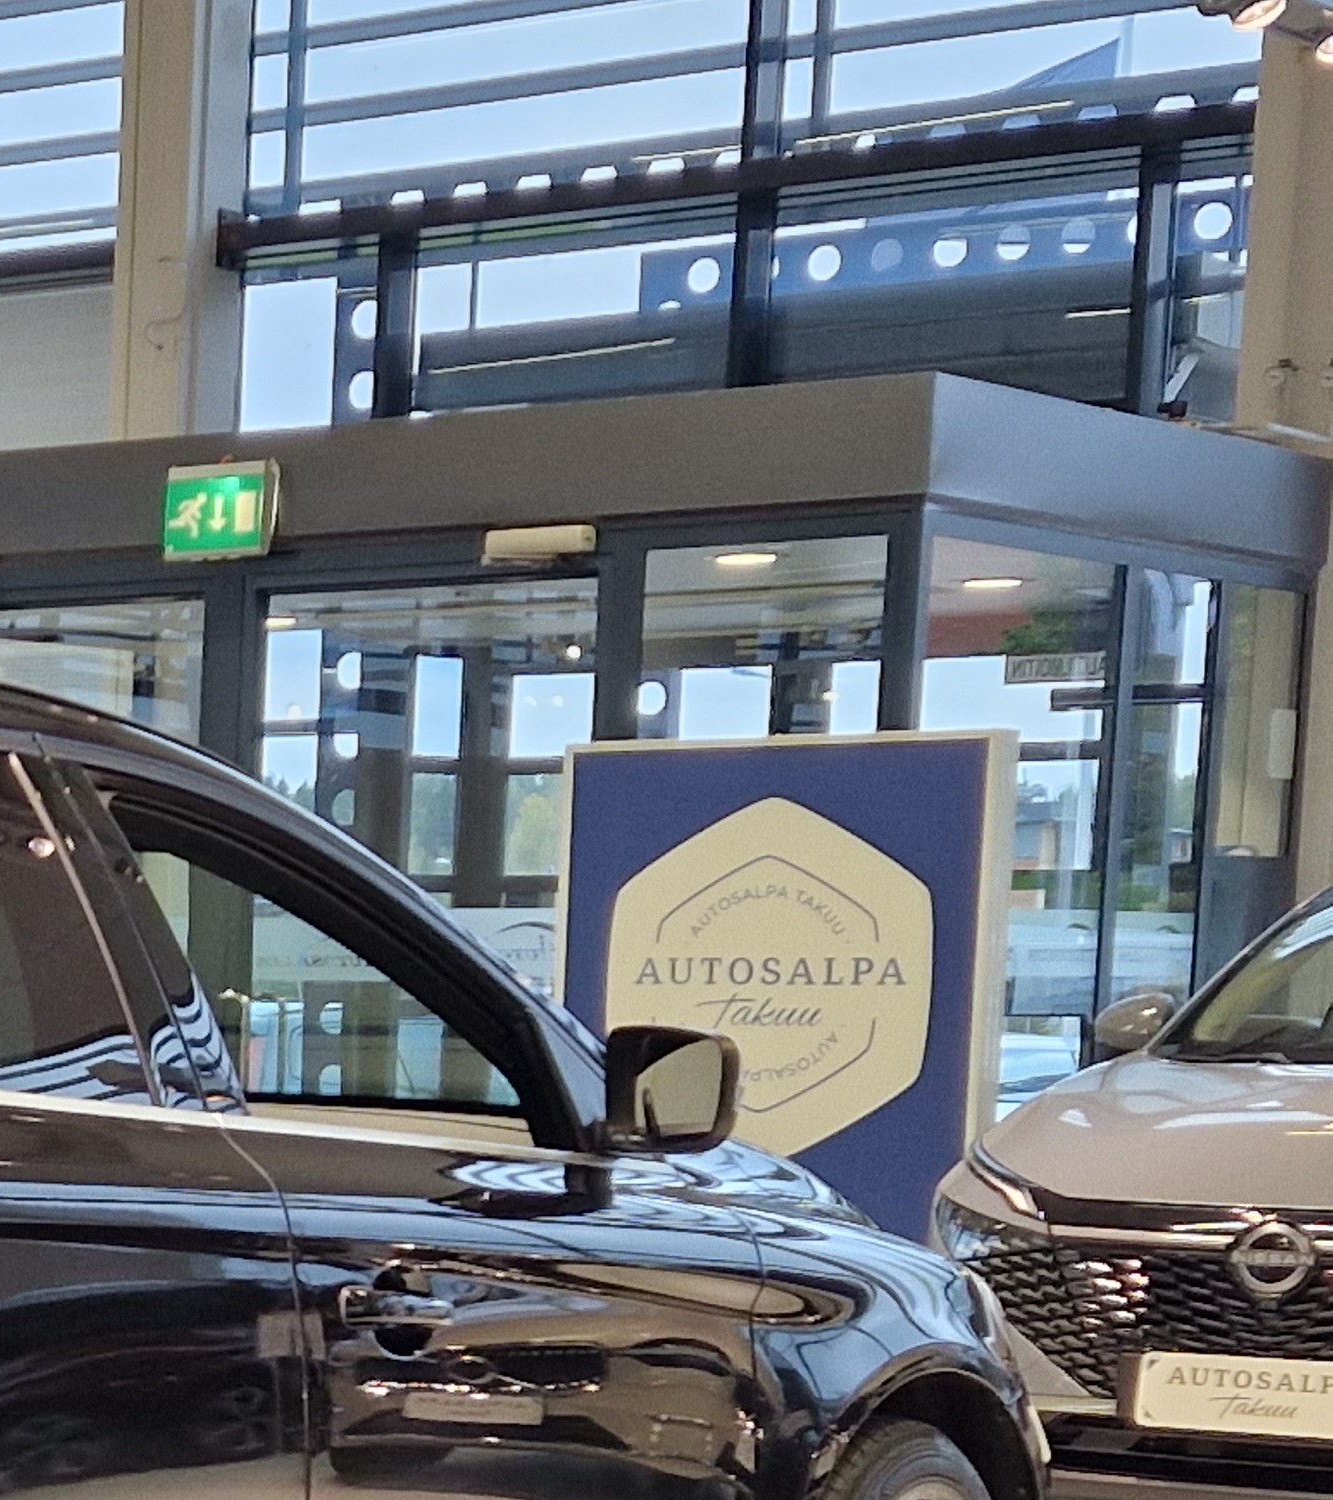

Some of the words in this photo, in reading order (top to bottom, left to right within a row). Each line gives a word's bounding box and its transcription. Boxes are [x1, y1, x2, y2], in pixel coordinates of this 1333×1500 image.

[690, 884, 789, 938] AUTOSALPA
[796, 889, 846, 936] TAKUU
[636, 957, 906, 986] AUTOSALPA
[696, 993, 823, 1029] Takuu
[1208, 1395, 1299, 1420] Takuu
